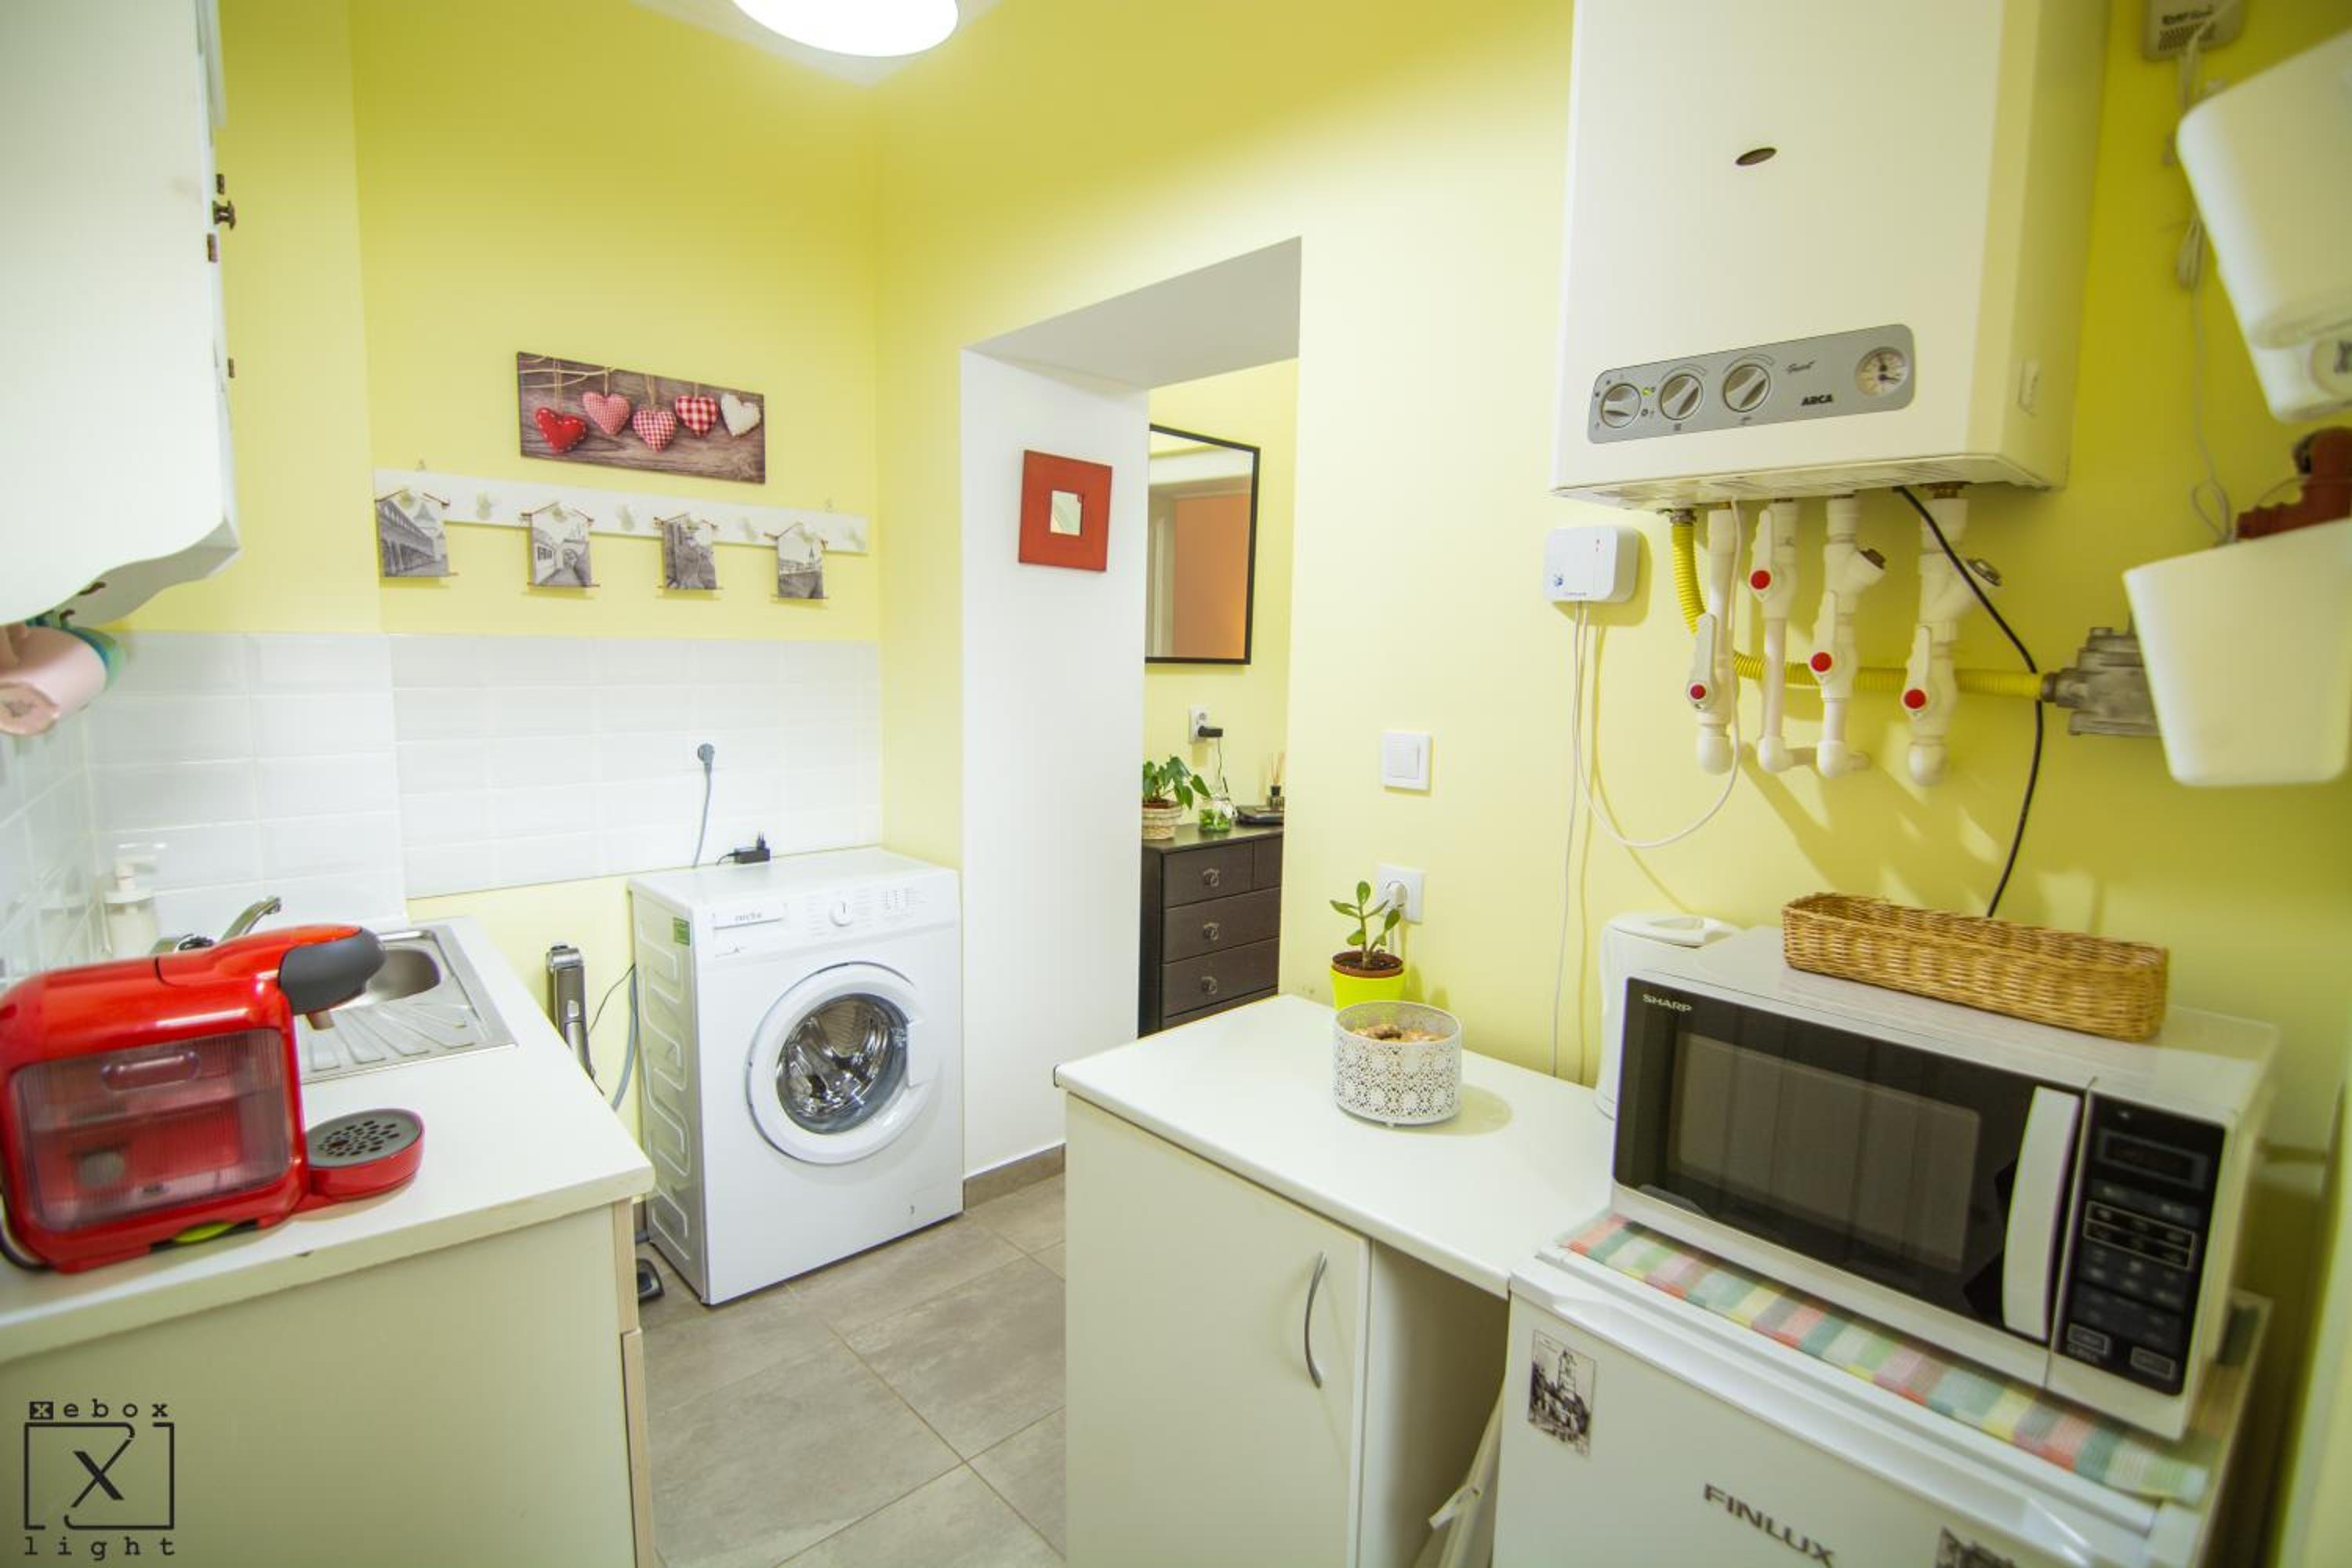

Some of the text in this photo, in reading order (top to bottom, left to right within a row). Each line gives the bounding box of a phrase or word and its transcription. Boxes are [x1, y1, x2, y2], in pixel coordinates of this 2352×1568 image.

[1802, 394, 1833, 406] ARCA
[1642, 993, 1693, 1012] SHARP
[1704, 1483, 1835, 1568] FINLUX
